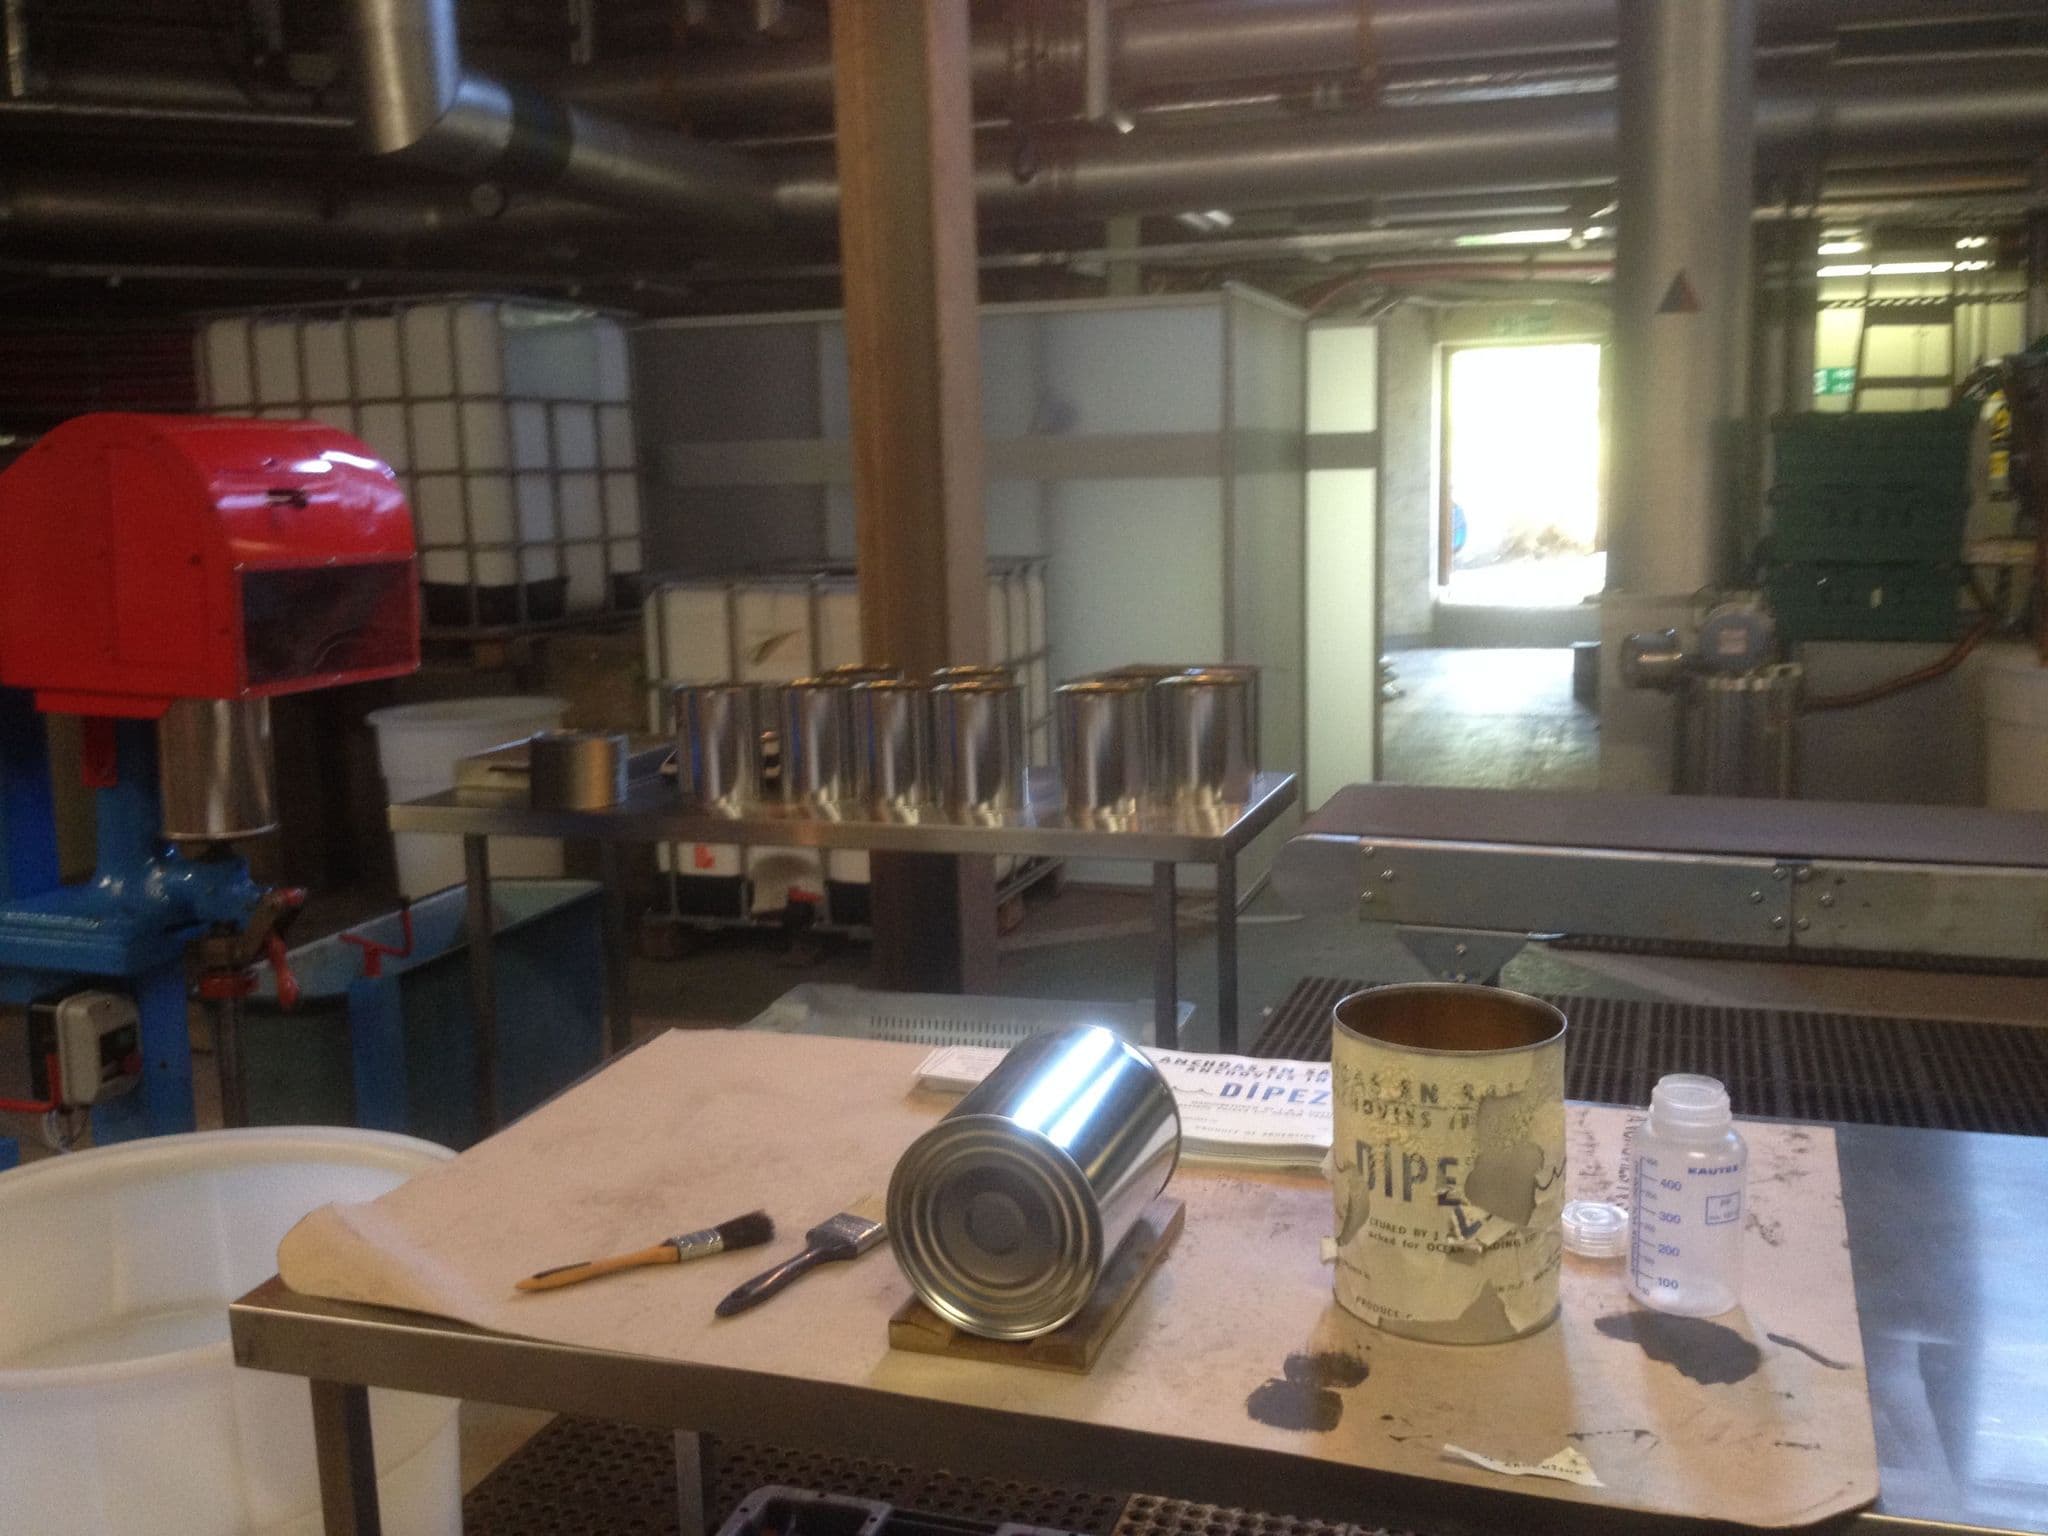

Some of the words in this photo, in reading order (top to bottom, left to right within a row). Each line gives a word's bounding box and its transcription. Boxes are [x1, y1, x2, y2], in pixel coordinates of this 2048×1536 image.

[1304, 1067, 1330, 1076] SA
[1660, 1178, 1682, 1192] 400
[1659, 1210, 1681, 1225] 300
[1402, 1238, 1419, 1250] for
[1657, 1243, 1680, 1257] 200
[1657, 1276, 1679, 1290] 100
